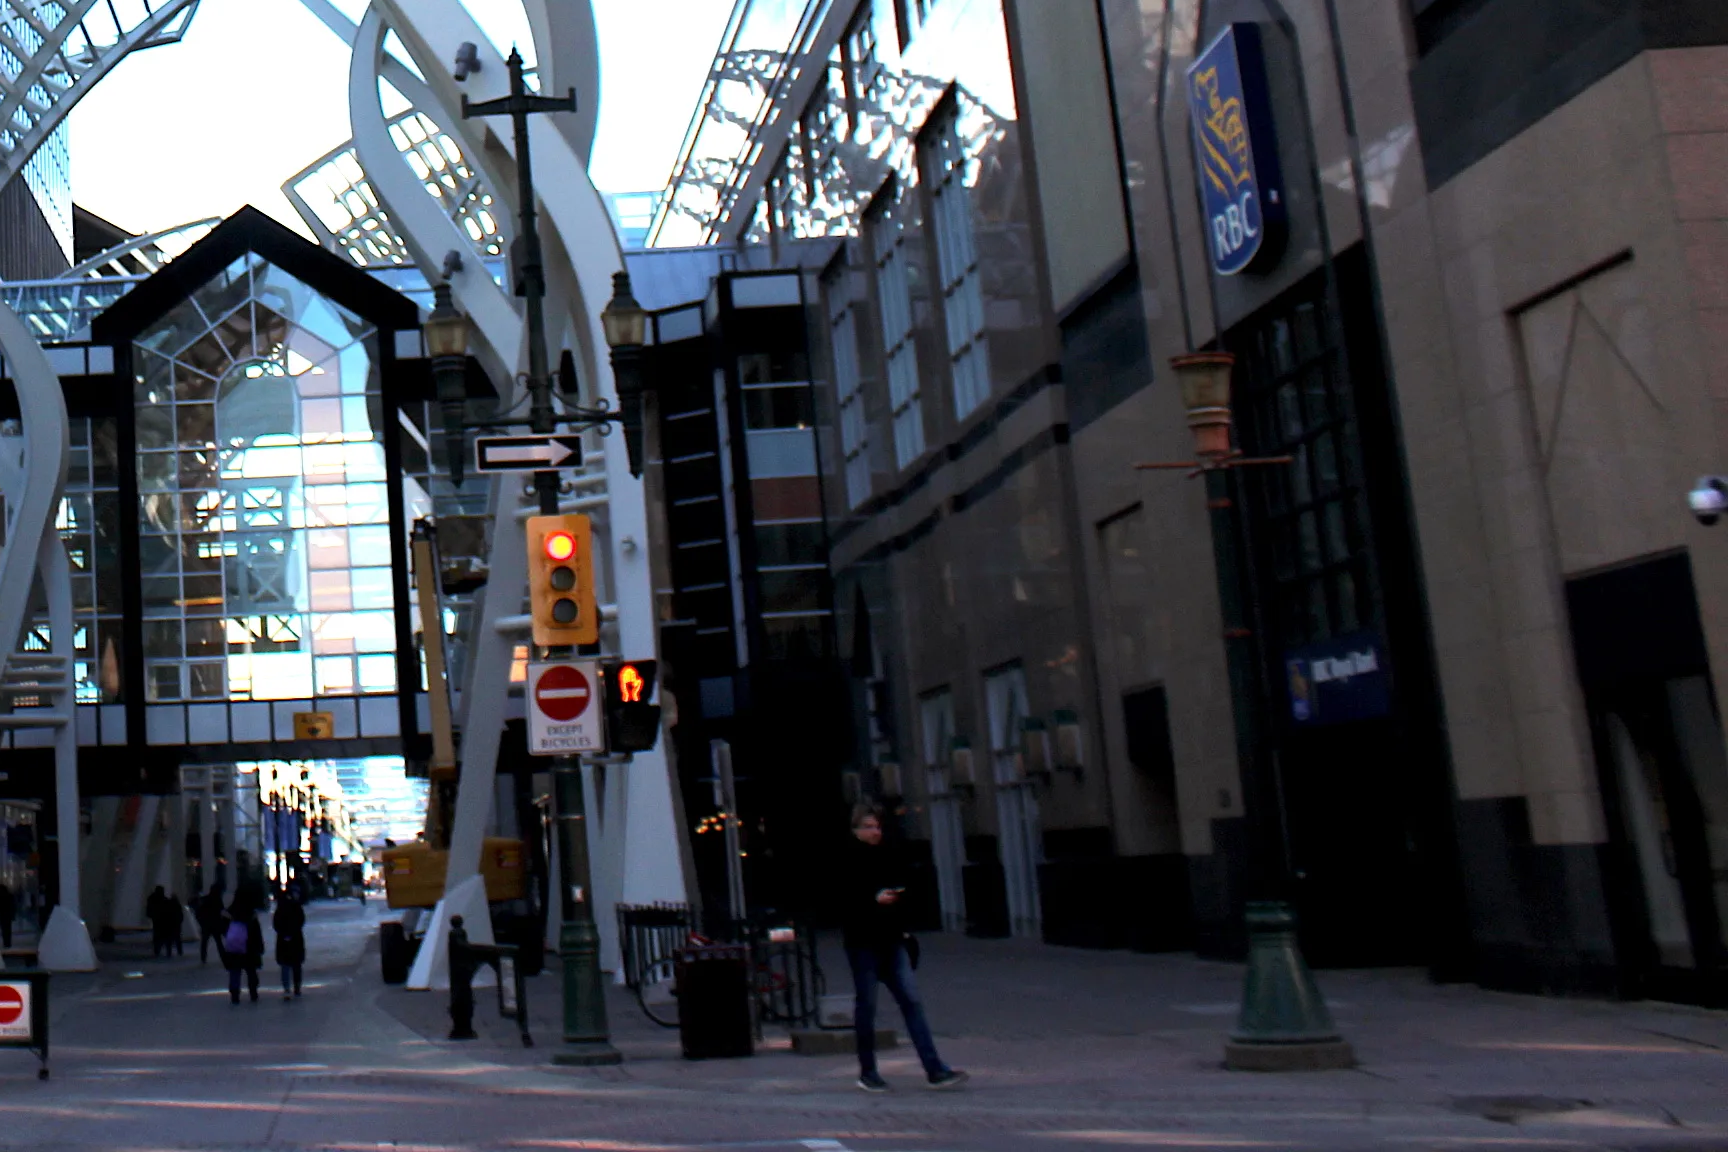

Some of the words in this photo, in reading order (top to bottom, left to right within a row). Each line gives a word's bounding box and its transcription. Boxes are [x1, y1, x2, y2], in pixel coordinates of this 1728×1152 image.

[1213, 190, 1257, 260] RBC
[547, 724, 583, 735] EXCEPT
[541, 736, 592, 748] BICYCLES
